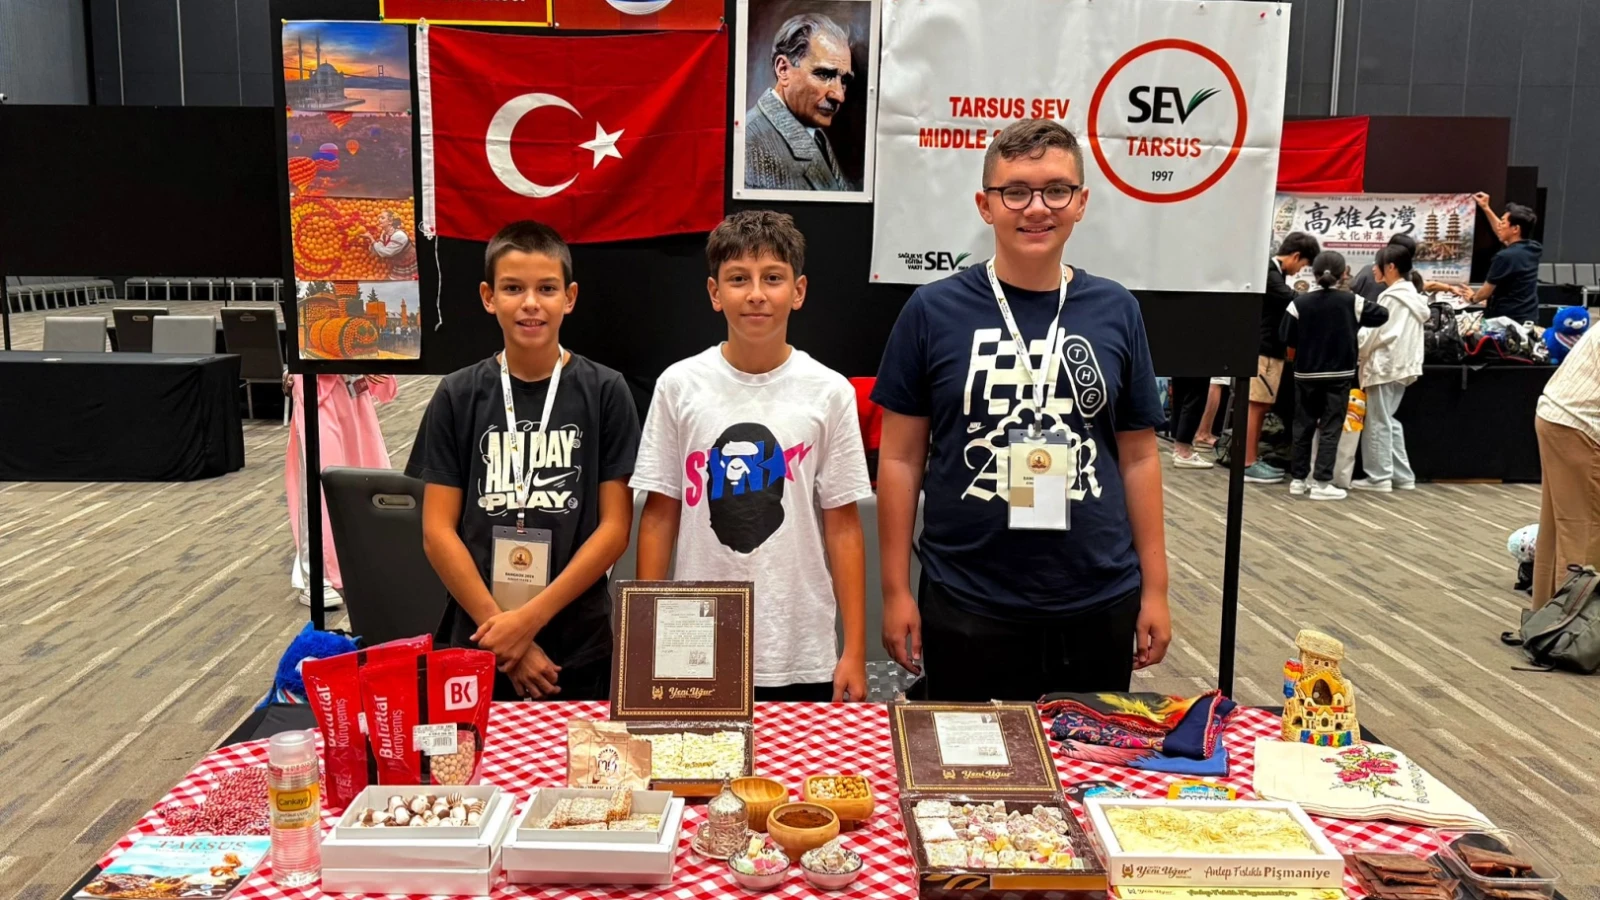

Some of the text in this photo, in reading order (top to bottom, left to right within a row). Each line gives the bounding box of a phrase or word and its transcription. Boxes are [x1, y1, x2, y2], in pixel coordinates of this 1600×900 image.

[949, 96, 1070, 119] TARSUS SEV
[1127, 85, 1222, 125] SEV
[919, 128, 987, 149] MIDDLE
[1126, 136, 1202, 158] TARSUS
[1151, 170, 1174, 182] 1997
[1304, 201, 1417, 236] 高雄台灣
[1337, 230, 1385, 241] 文化市集
[924, 251, 972, 271] SEV
[530, 430, 577, 470] DAY
[485, 490, 573, 512] PLAY
[450, 681, 472, 704] BK
[335, 698, 351, 748] Kuruyemiş
[374, 694, 393, 759] Bulutlar
[390, 709, 406, 760] Kuruyemiş
[158, 840, 246, 851] TARSUS
[1136, 865, 1160, 879] Yeni
[1204, 865, 1232, 880] Antep
[1263, 866, 1331, 880] Pişmaniye
